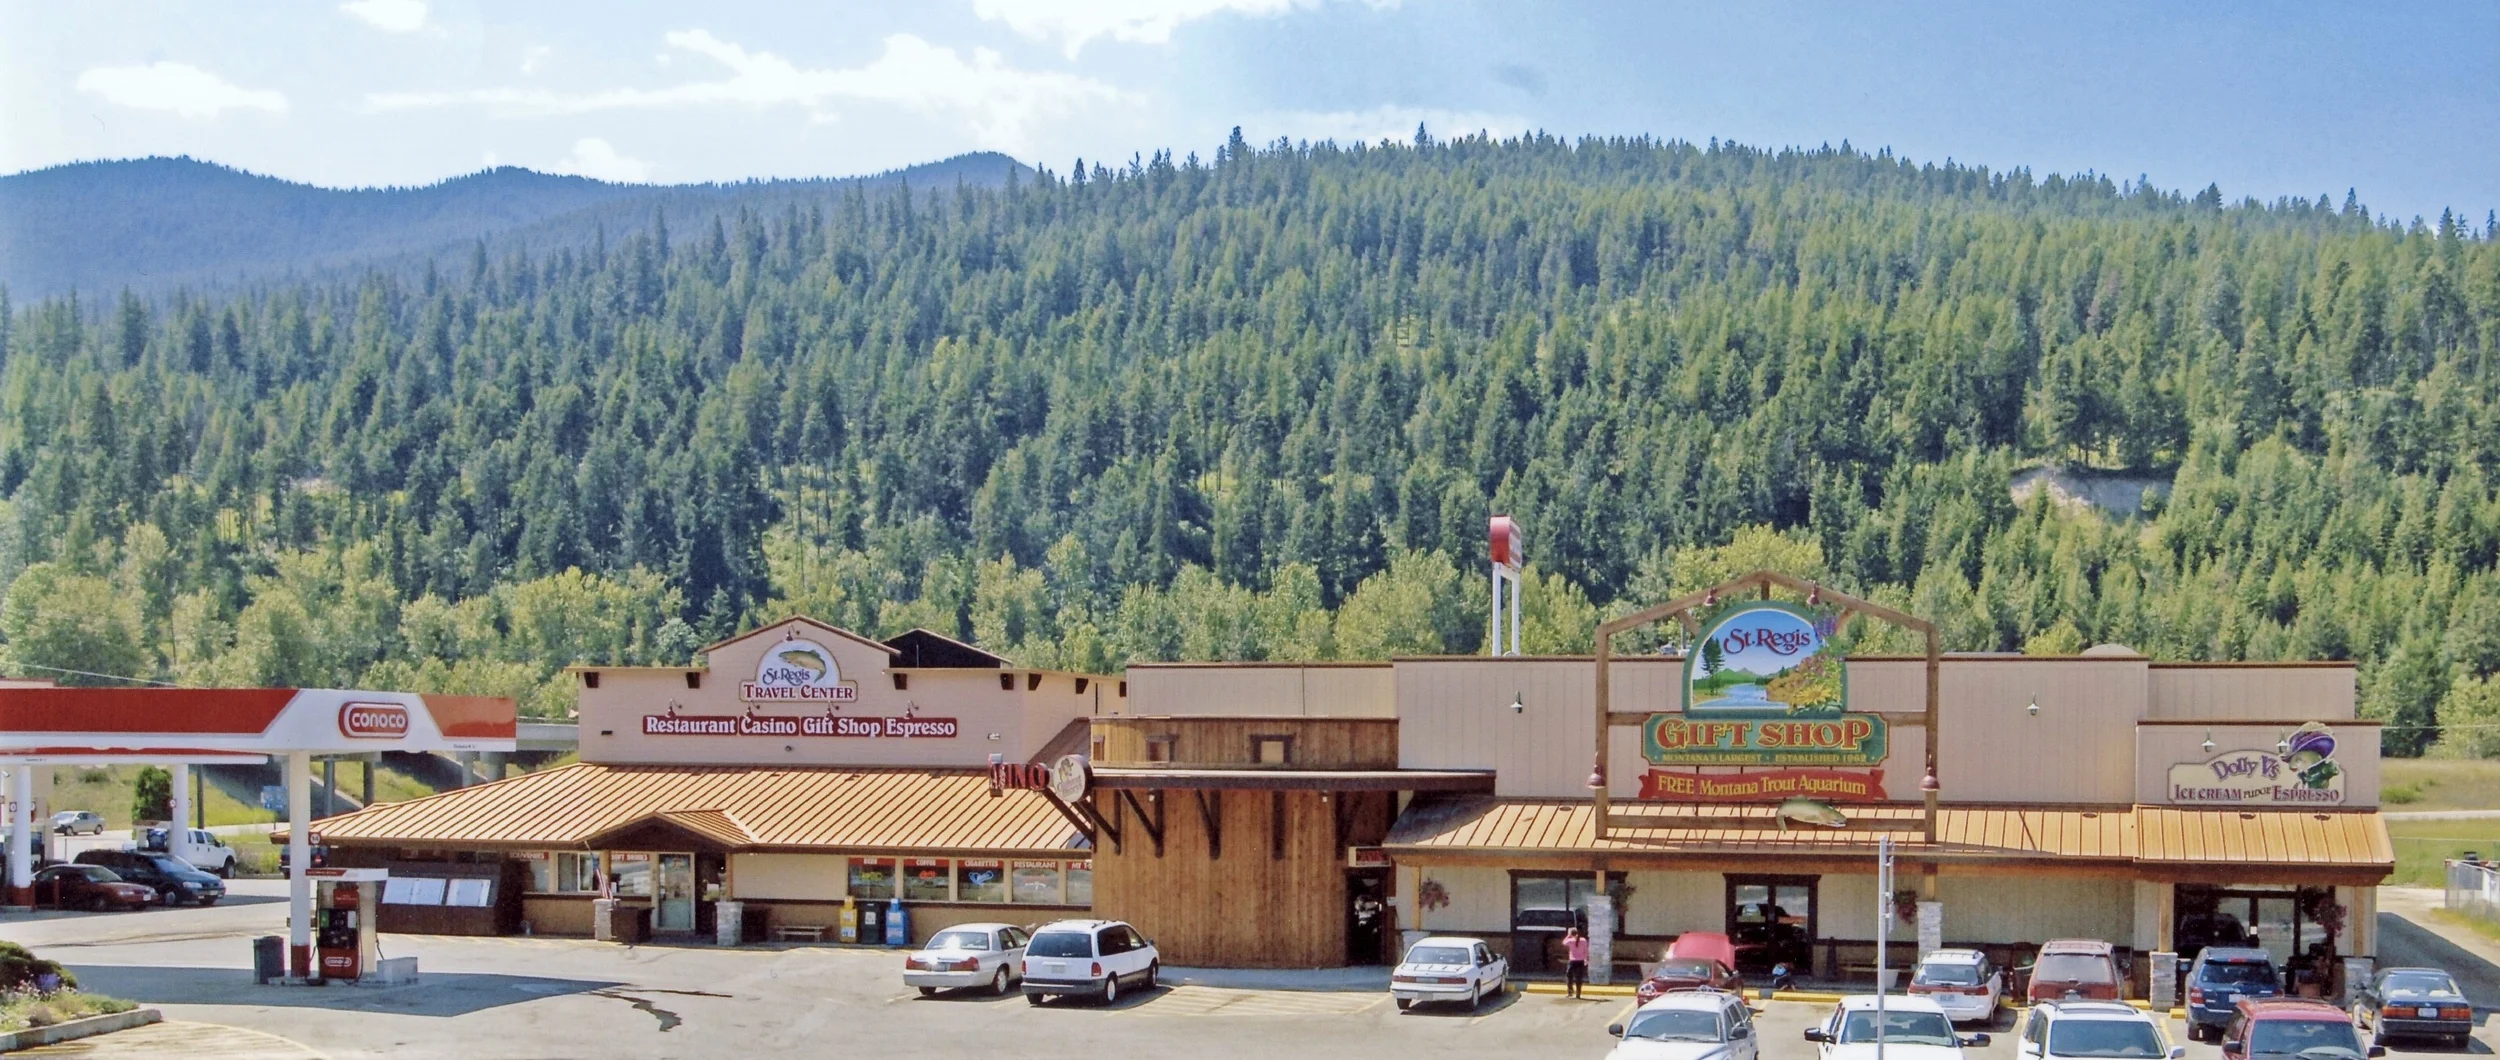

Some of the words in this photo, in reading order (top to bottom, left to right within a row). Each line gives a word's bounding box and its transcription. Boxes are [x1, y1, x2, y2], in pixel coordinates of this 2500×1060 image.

[1756, 628, 1811, 656] Regis
[780, 668, 811, 687] Regis
[743, 684, 796, 699] TRAVEL
[800, 685, 853, 699] CENTER
[646, 716, 736, 733] Restaurant
[741, 717, 797, 734] Casino
[803, 717, 834, 734] Gift
[837, 718, 881, 737] Shop
[886, 718, 956, 738] Espresso
[1656, 718, 1753, 750] GIFT
[1757, 718, 1872, 750] SHOP
[2210, 756, 2259, 782] Dolly
[1658, 775, 1695, 795] FREE
[1699, 779, 1759, 796] Montana
[1761, 776, 1796, 793] Trout
[1798, 774, 1867, 795] Aquarium
[2174, 784, 2196, 800] ICE
[2198, 787, 2242, 800] CREAM
[2272, 785, 2340, 801] ESPRESSO
[1014, 861, 1056, 869] RESTAURANT
